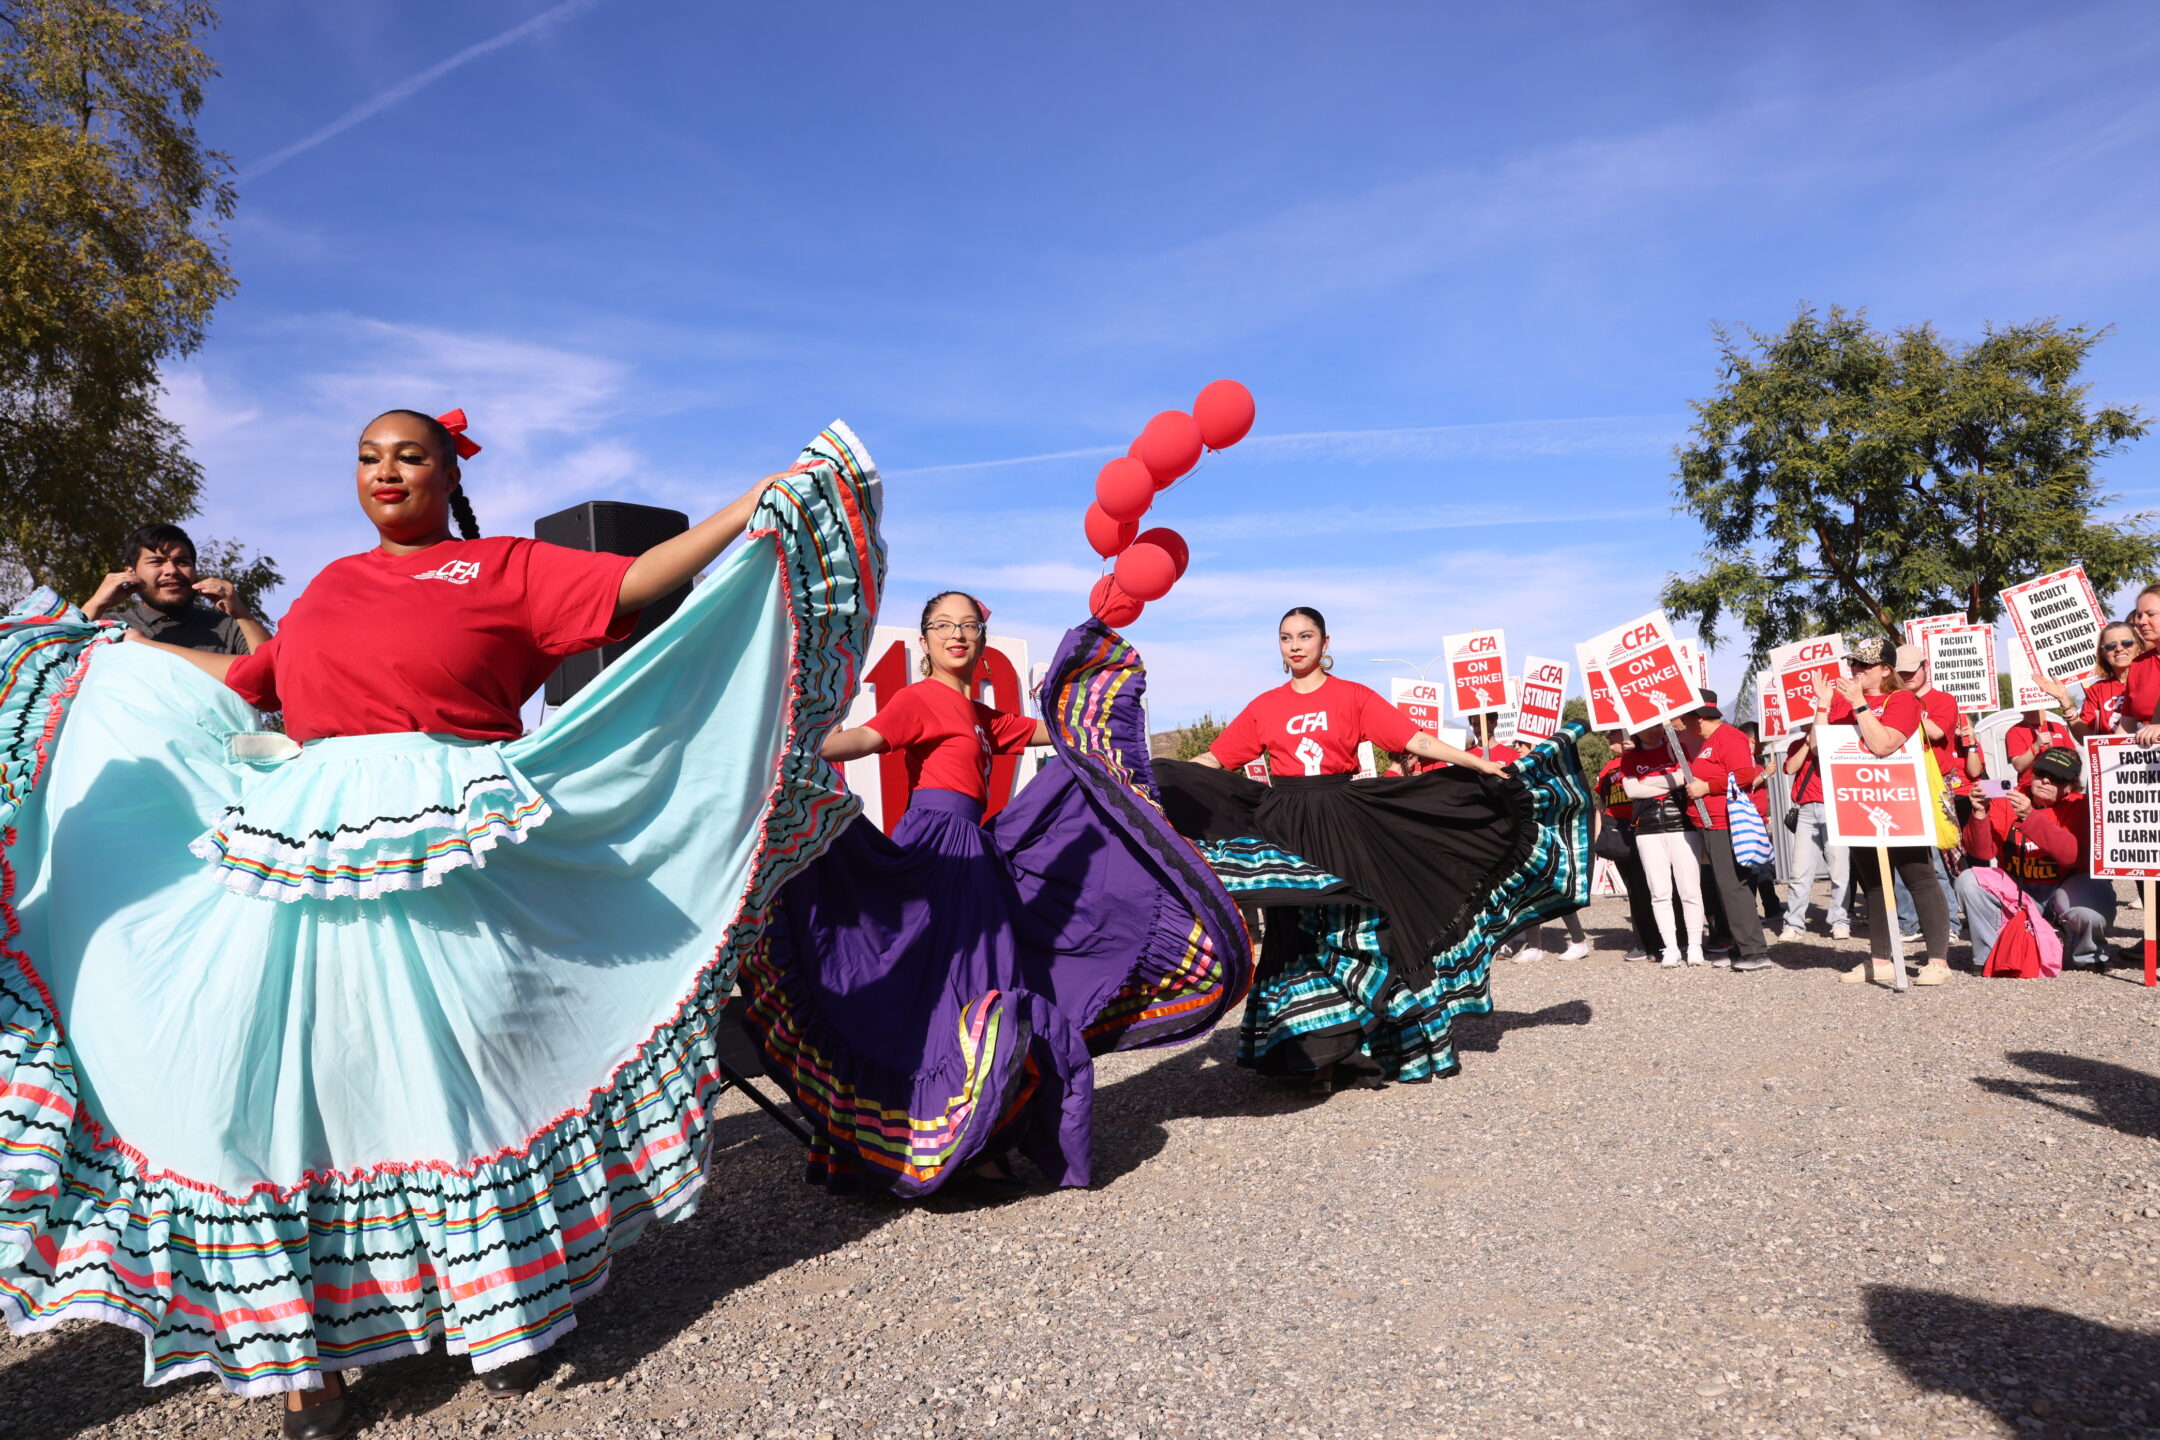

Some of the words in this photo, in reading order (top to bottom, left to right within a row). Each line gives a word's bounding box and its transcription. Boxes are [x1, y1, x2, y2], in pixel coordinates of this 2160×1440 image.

[436, 560, 480, 579] CFA
[2028, 584, 2068, 604] FACULTY
[2030, 597, 2078, 619] WORKING
[2031, 608, 2089, 635] CONDITIONS
[1468, 636, 1496, 652] CFA
[1621, 622, 1660, 650] CFA
[1940, 635, 1973, 645] FACULTY
[2035, 636, 2054, 650] ARE
[2054, 622, 2097, 644] STUDENT
[1799, 642, 1833, 661] CFA
[1938, 646, 1977, 657] WORKING
[2048, 639, 2095, 662] LEARNING
[1467, 661, 1488, 673] ON
[1628, 655, 1656, 675] ON
[1934, 658, 1983, 669] CONDITIONS
[1457, 672, 1503, 688] STRIKE!
[1540, 665, 1563, 684] CFA
[1620, 664, 1679, 697] STRIKE!
[1934, 672, 1948, 681] ARE
[1951, 669, 1986, 680] STUDENT
[1413, 686, 1437, 700] CFA
[1942, 682, 1980, 692] LEARNING
[1523, 686, 1560, 711] STRIKE
[2104, 696, 2124, 711] CF
[1409, 706, 1427, 716] ON
[1286, 711, 1328, 734] CFA
[1519, 711, 1556, 736] READY!
[1856, 768, 1890, 782] ON
[2091, 753, 2100, 795] Association
[1837, 787, 1916, 802] STRIKE!
[2107, 810, 2130, 823] ARE
[2094, 825, 2102, 860] California
